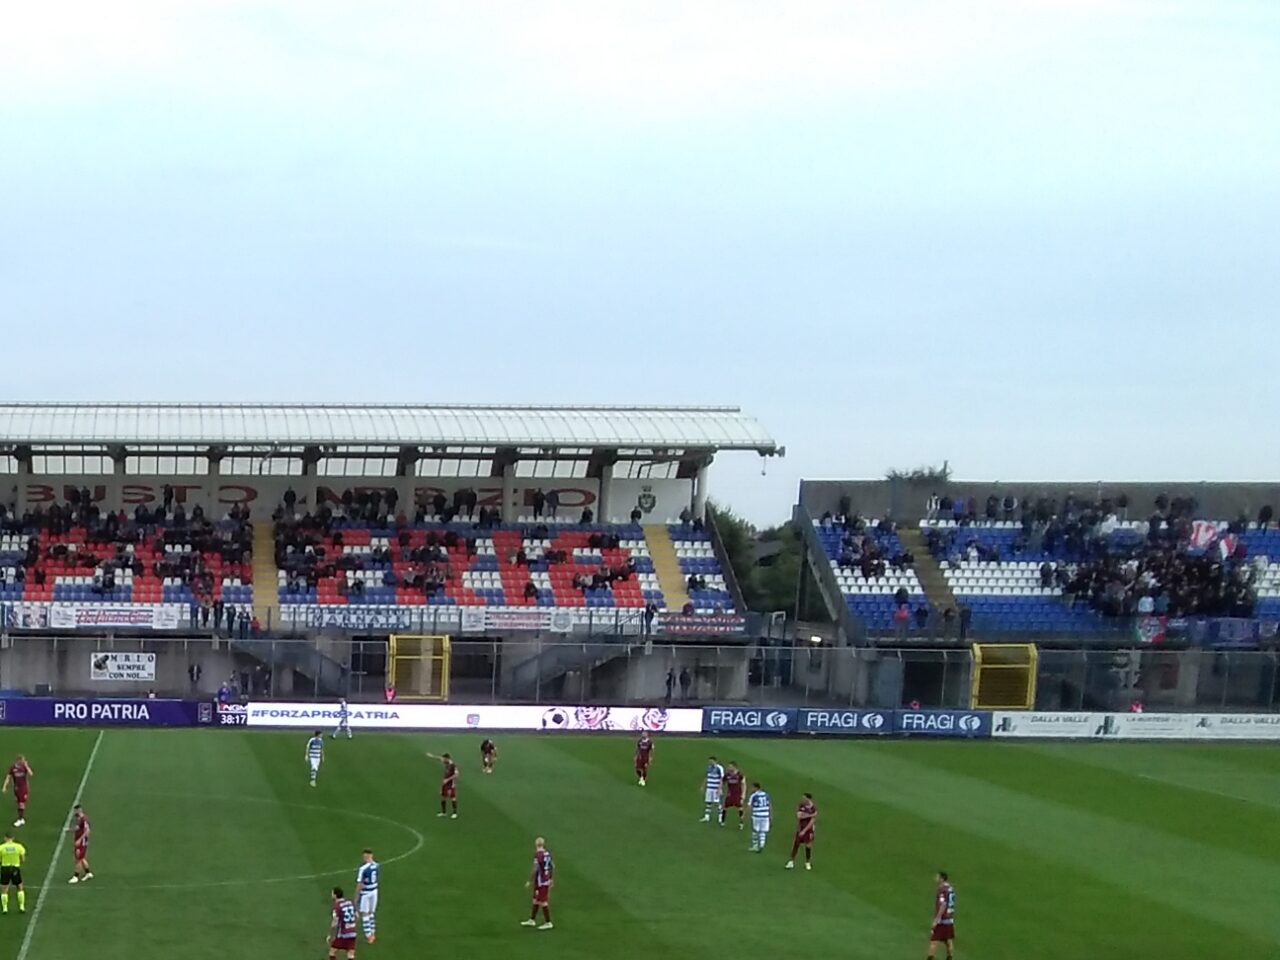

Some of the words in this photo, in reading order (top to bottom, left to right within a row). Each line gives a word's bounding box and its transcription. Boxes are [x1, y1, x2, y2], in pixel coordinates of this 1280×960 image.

[54, 704, 87, 719] PRO
[91, 704, 150, 719] PATRIA
[221, 714, 247, 724] 38:17
[711, 711, 761, 726] FRAGI
[807, 712, 857, 727] FRAGI
[903, 714, 954, 728] FRAGI
